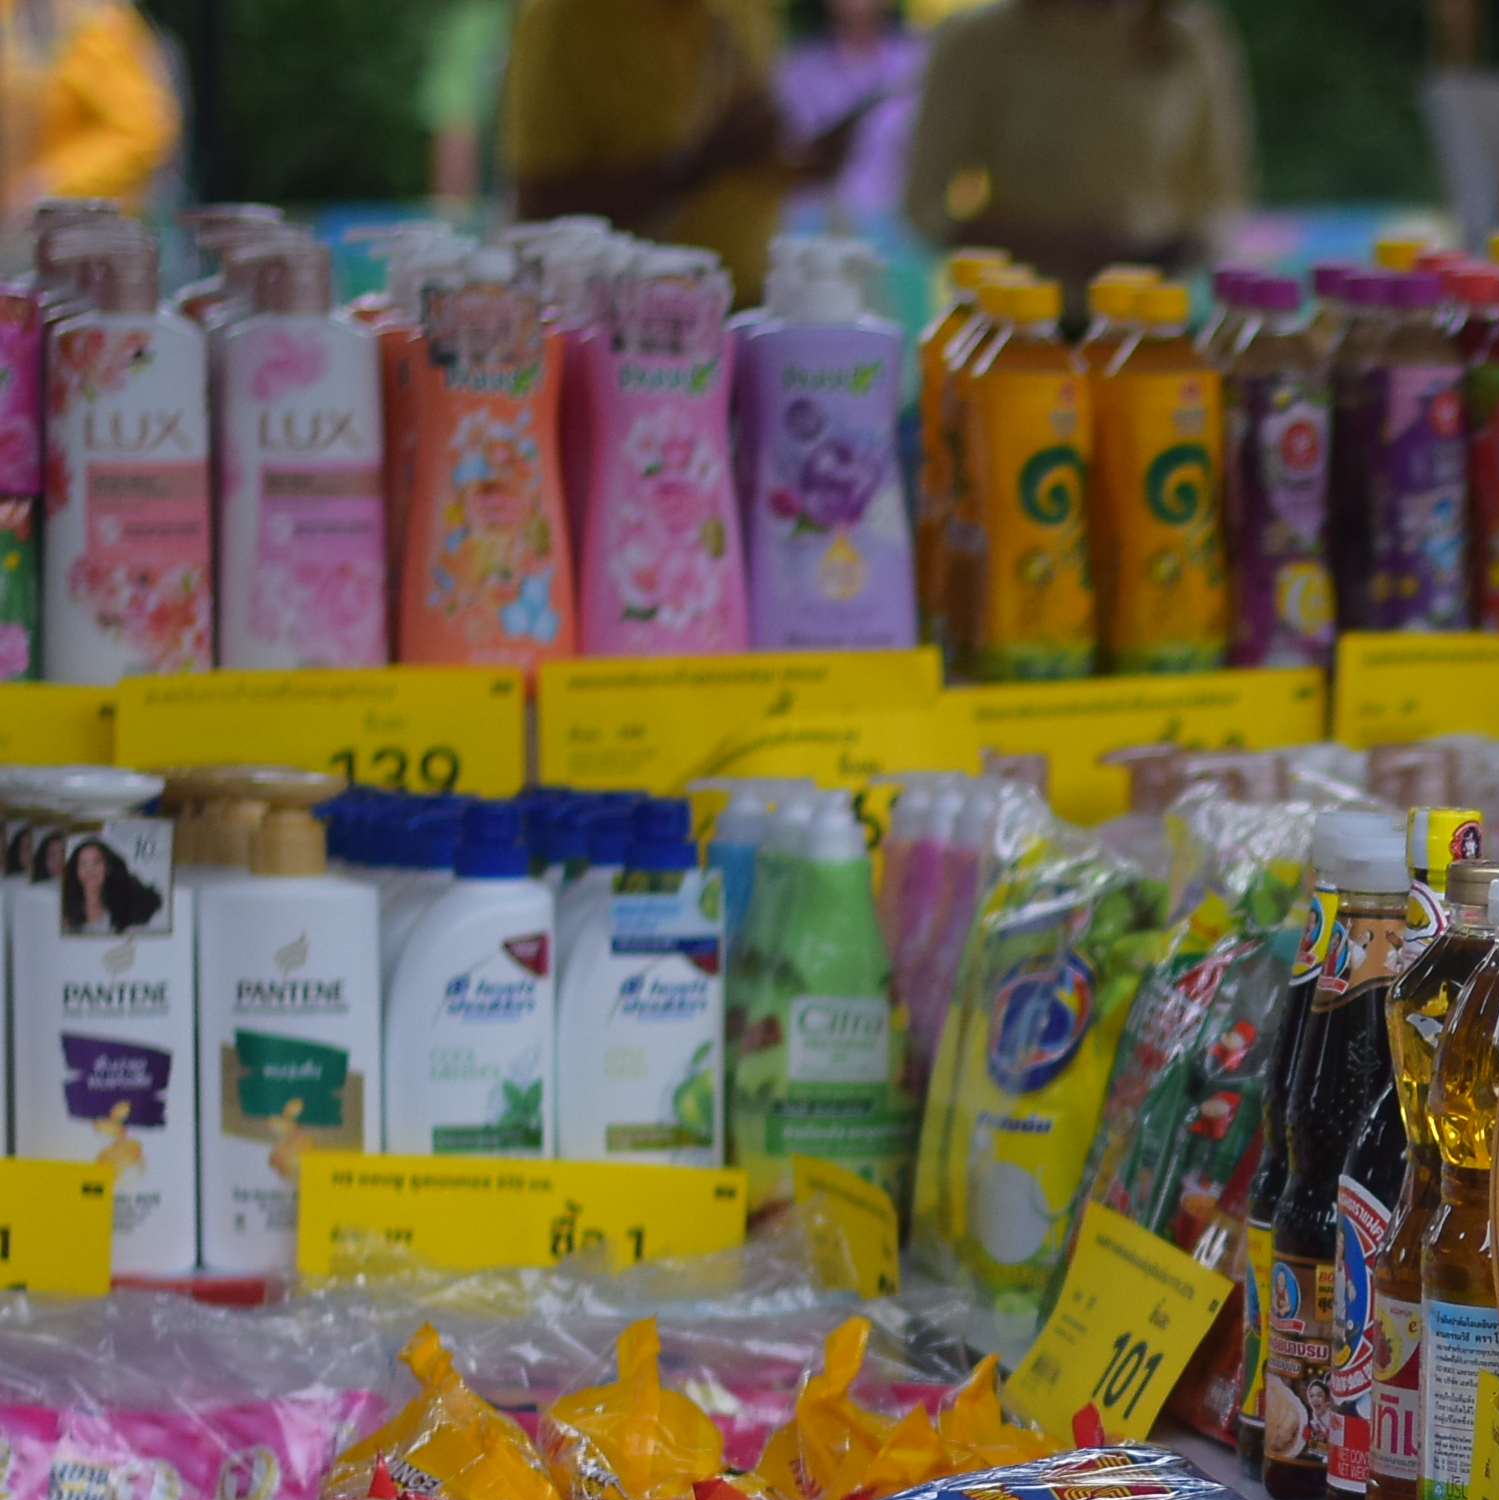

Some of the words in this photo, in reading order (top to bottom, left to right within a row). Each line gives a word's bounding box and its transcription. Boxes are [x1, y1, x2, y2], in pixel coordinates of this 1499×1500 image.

[85, 410, 192, 451] LUX
[258, 410, 364, 451] LUX
[63, 980, 168, 1004] PANTENE
[236, 979, 345, 1003] PANTENE
[1091, 1331, 1165, 1420] 101
